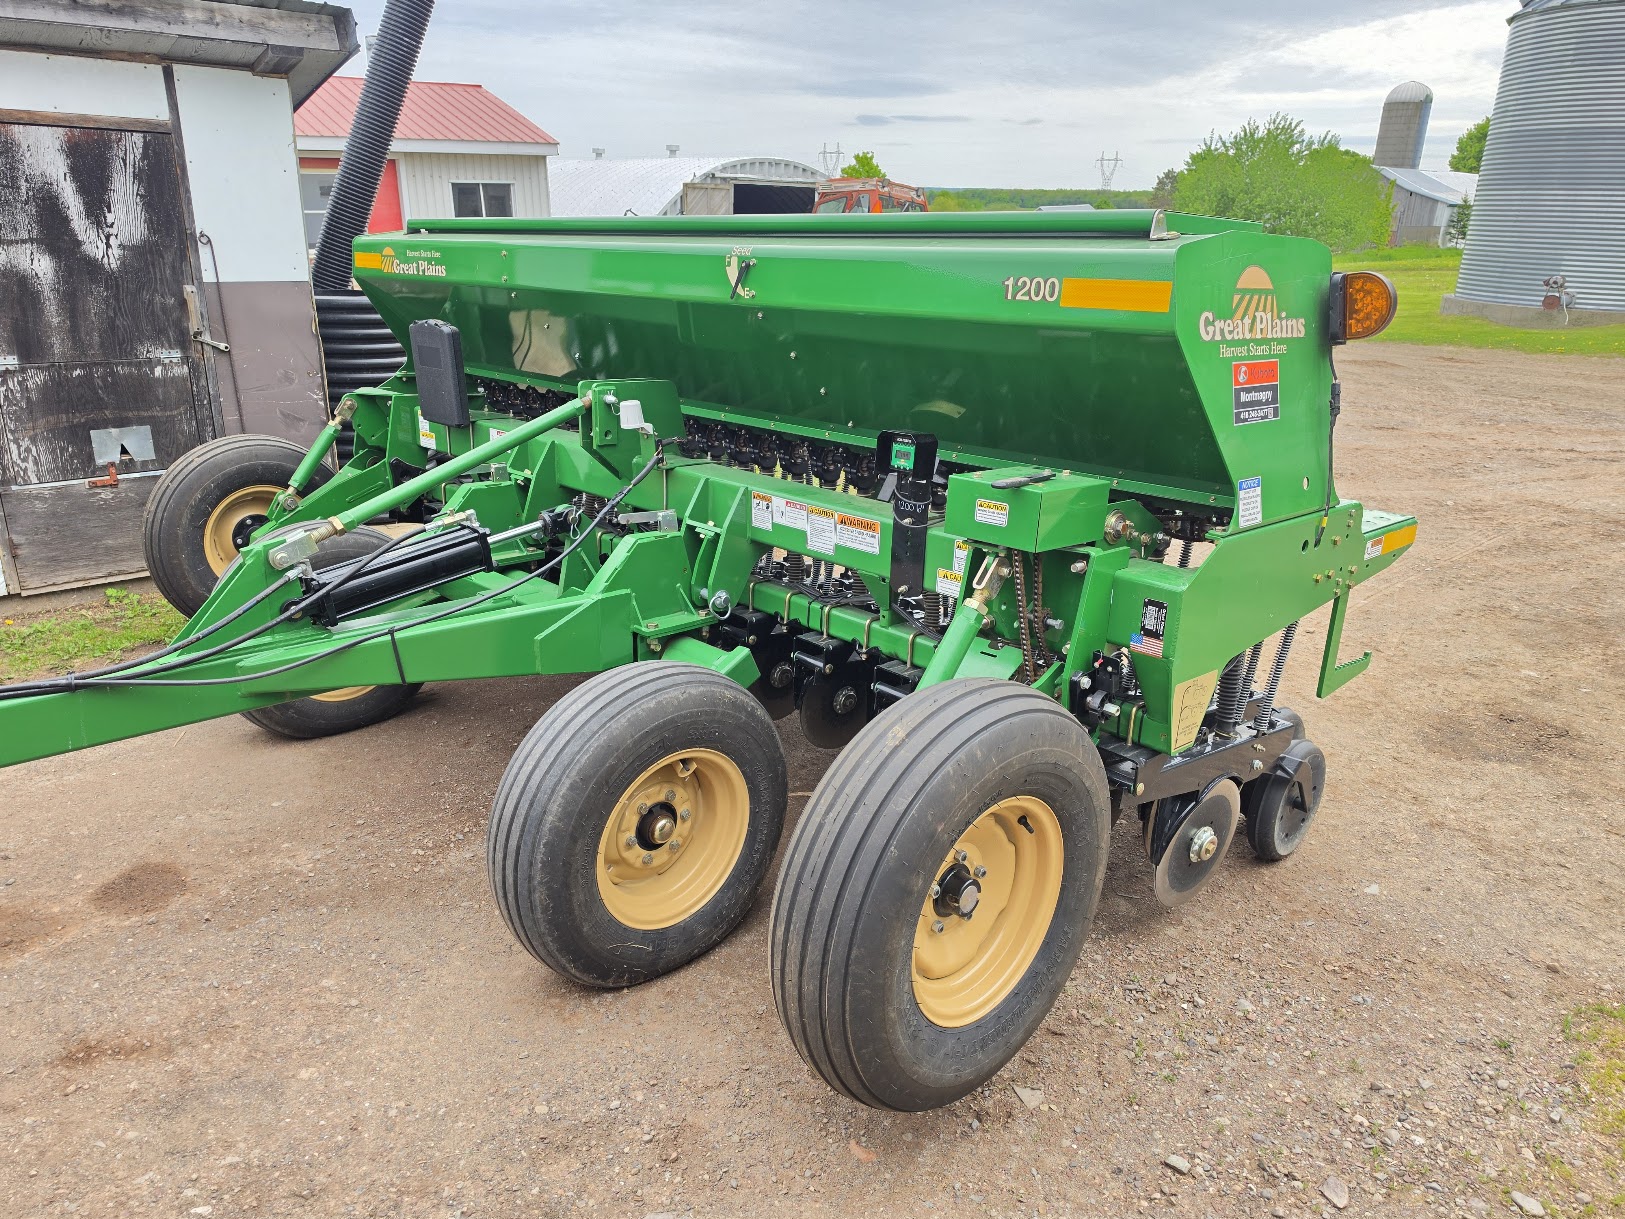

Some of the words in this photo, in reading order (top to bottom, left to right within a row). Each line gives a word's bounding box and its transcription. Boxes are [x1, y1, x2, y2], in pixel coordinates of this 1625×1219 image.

[732, 245, 753, 256] Seed
[726, 254, 731, 266] F
[393, 259, 418, 274] Great
[418, 260, 446, 277] Plains
[744, 288, 750, 298] E
[1002, 276, 1060, 302] 1200
[1199, 311, 1252, 341] Great
[1254, 311, 1306, 339] Plains
[1220, 344, 1248, 358] Harvest
[1250, 342, 1270, 356] Starts
[1270, 342, 1287, 354] Here
[1240, 390, 1273, 402] Montmagny
[1242, 478, 1259, 490] NOTICE
[814, 508, 834, 518] CAUTION
[983, 502, 1006, 512] CAUTION
[846, 516, 876, 532] WARNING
